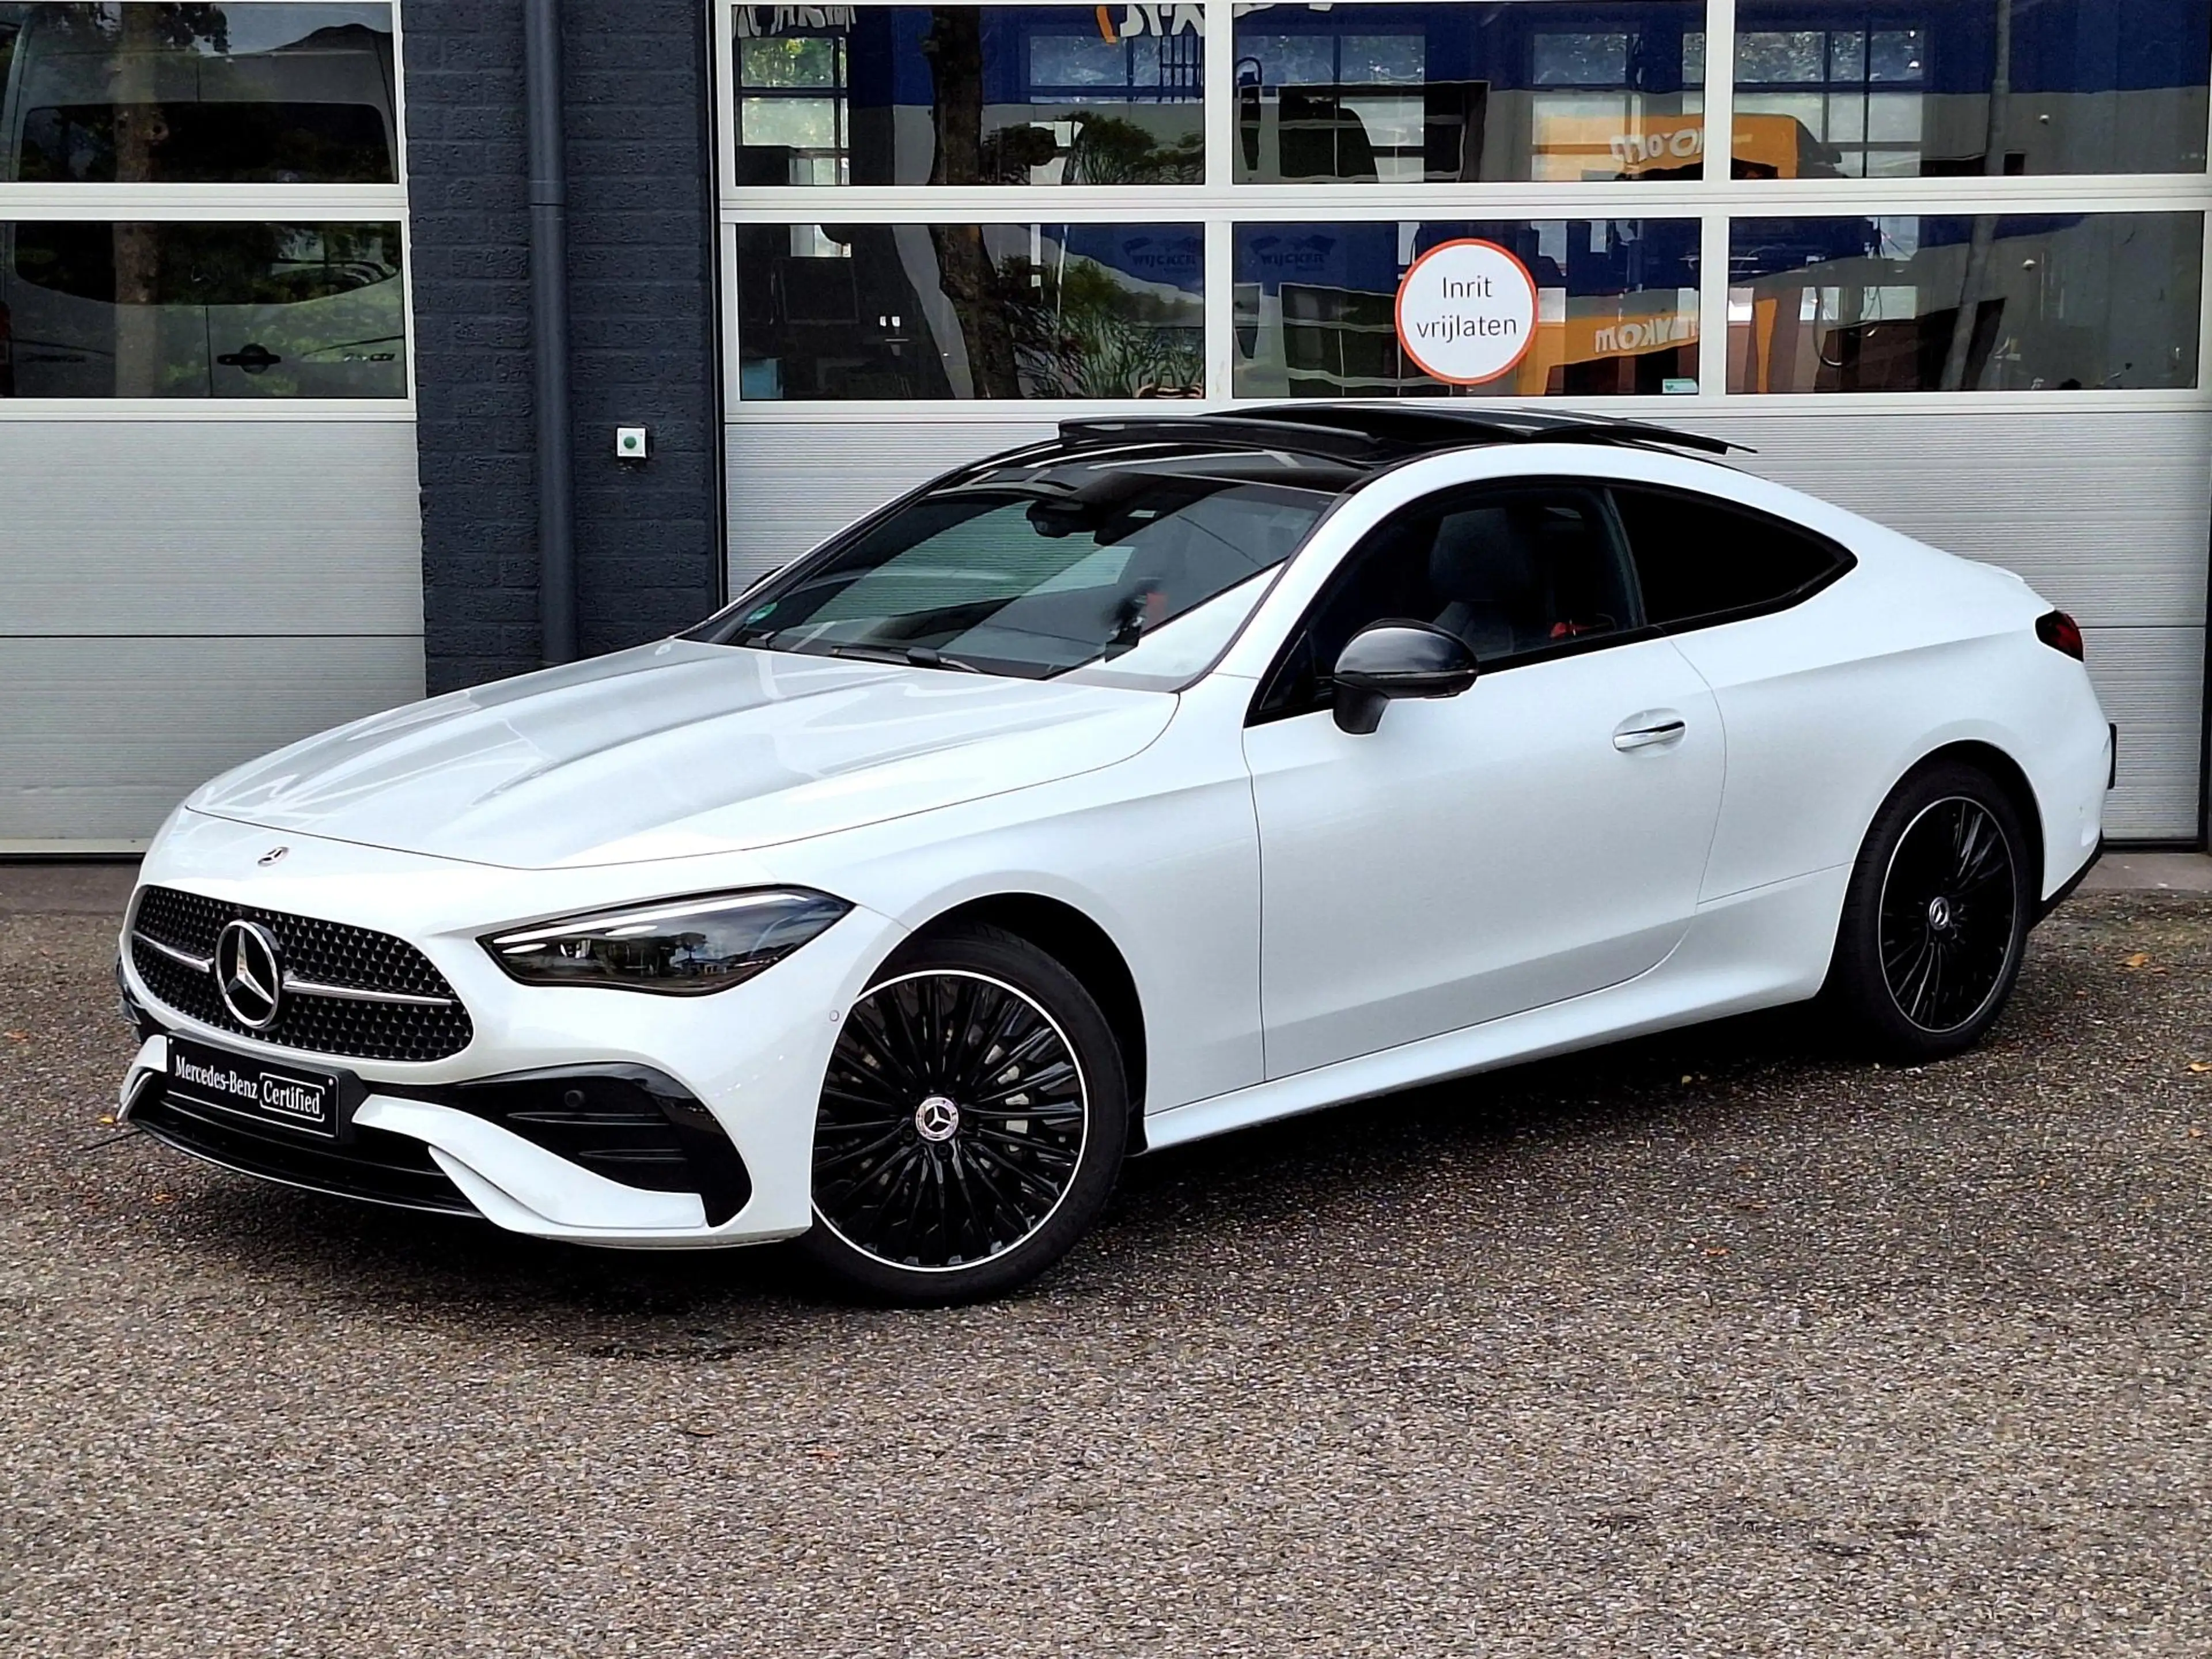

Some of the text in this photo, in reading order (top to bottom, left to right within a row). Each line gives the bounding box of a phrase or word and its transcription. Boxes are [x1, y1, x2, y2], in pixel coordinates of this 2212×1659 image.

[1442, 275, 1493, 299] Inrit
[1416, 315, 1517, 343] vrijlaten
[175, 1054, 320, 1115] Mercedes-Benz Certified
